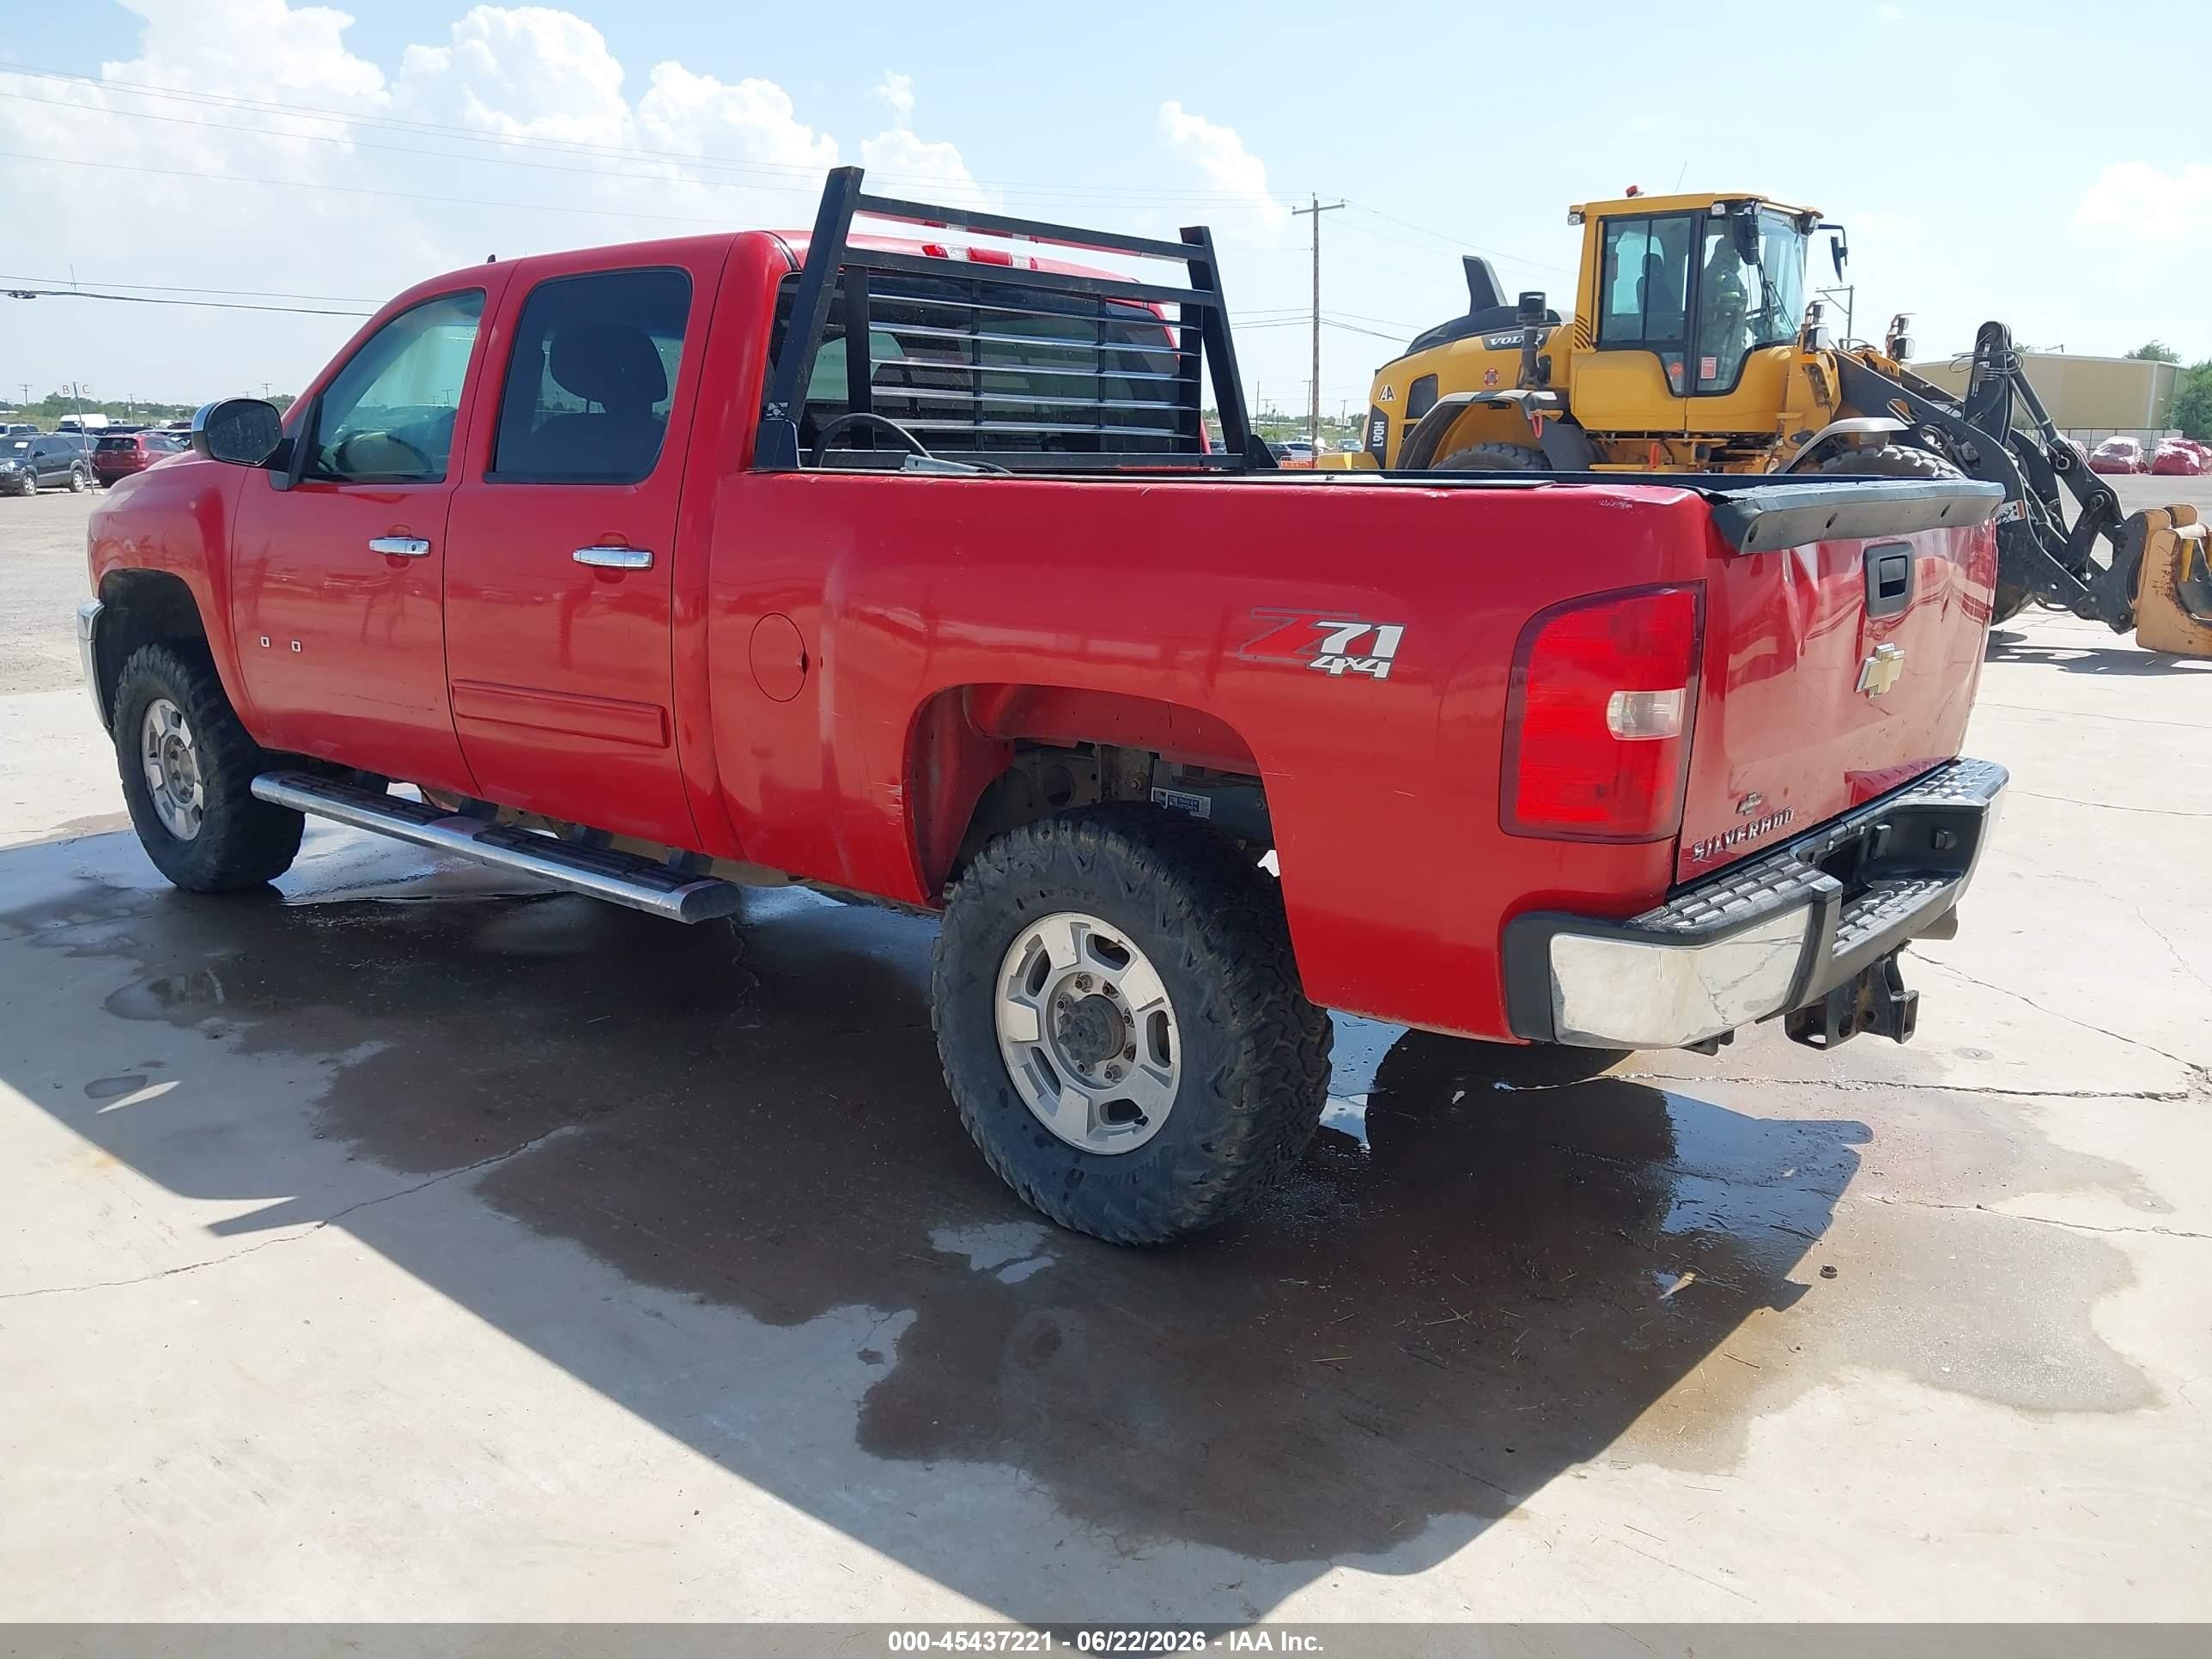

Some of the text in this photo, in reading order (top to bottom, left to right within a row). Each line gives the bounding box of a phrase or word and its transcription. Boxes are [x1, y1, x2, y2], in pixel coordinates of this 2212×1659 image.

[1489, 334, 1544, 346] VOLO
[62, 385, 70, 395] B
[82, 384, 90, 394] C
[1372, 421, 1386, 447] L90H
[1237, 606, 1407, 664] Z71
[1692, 806, 1794, 861] SILVERADO
